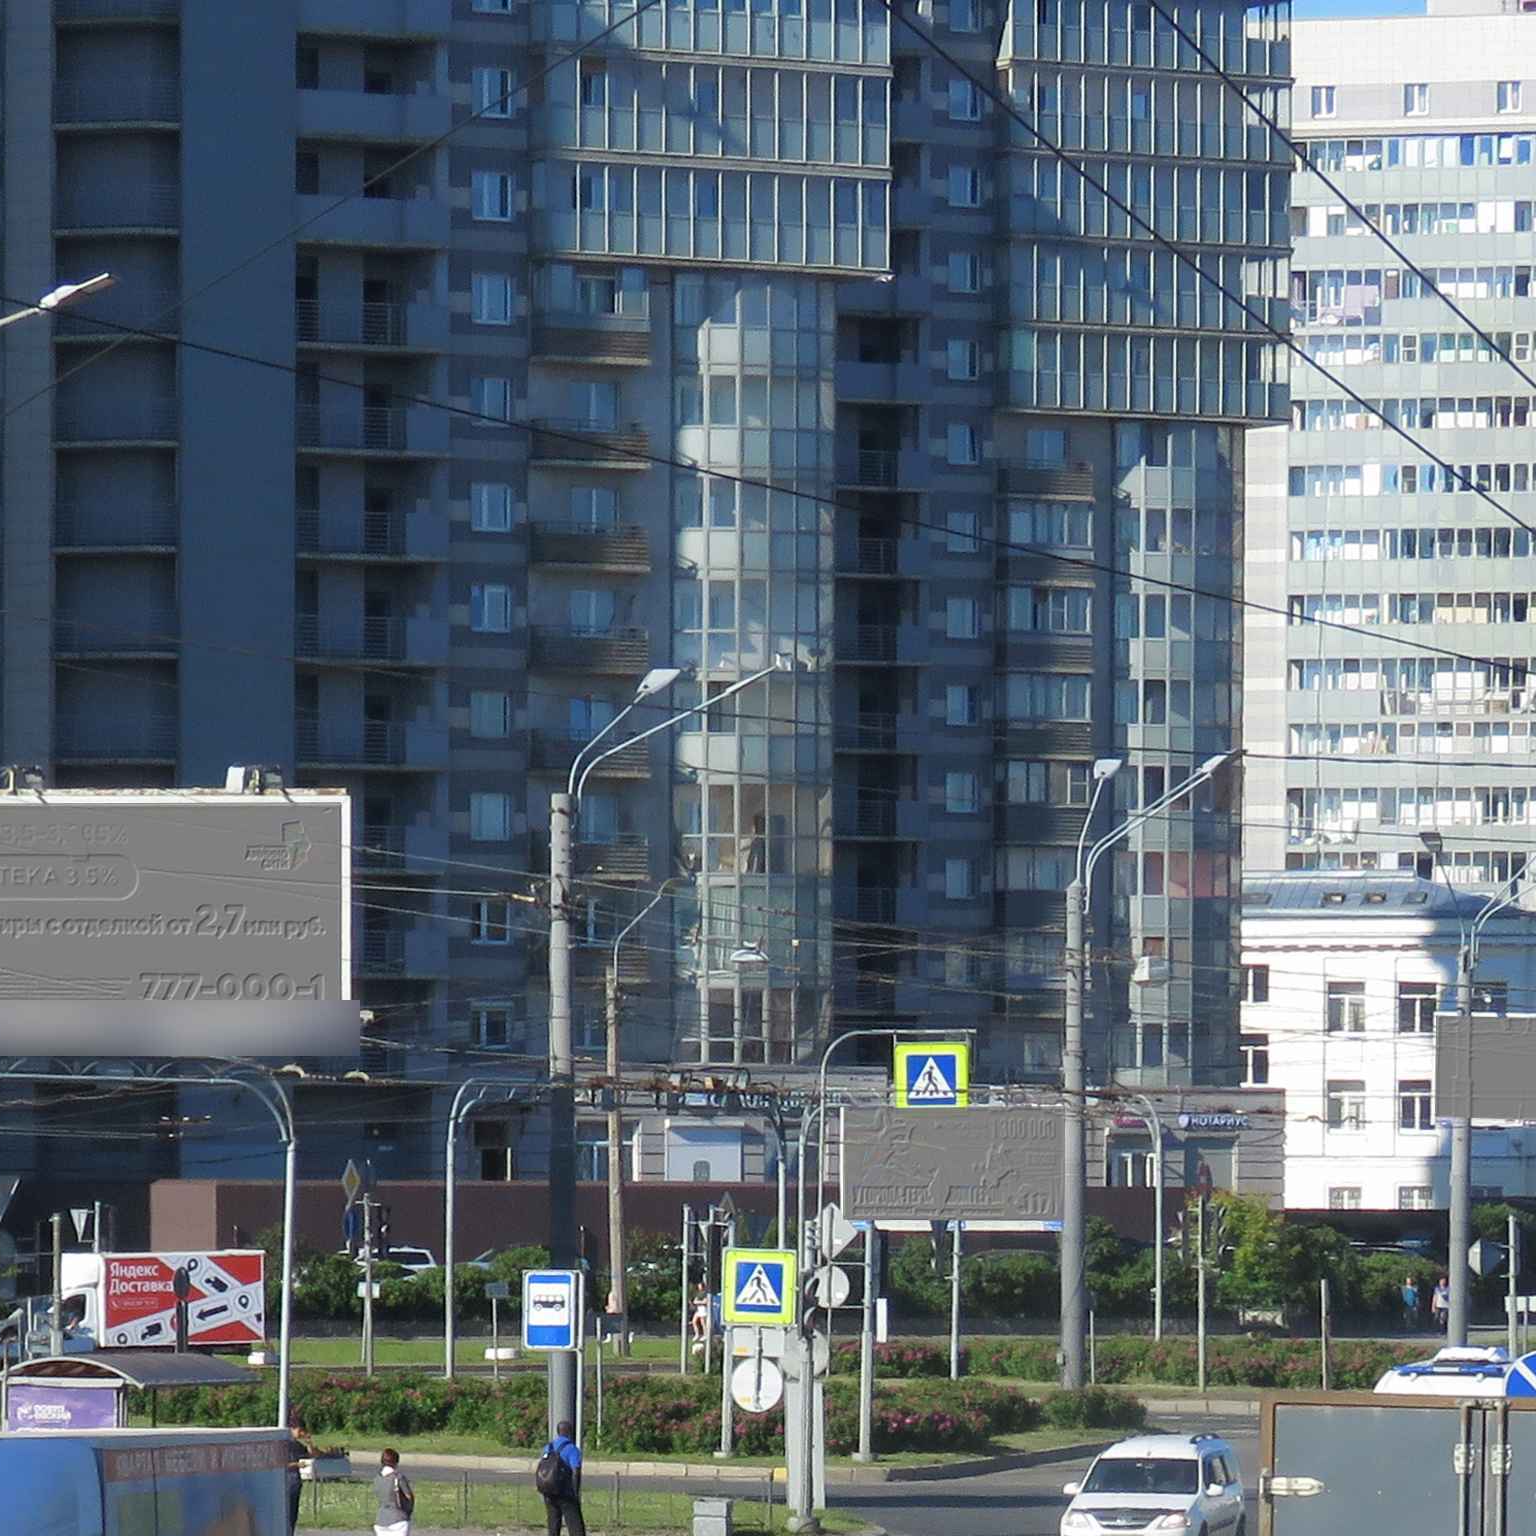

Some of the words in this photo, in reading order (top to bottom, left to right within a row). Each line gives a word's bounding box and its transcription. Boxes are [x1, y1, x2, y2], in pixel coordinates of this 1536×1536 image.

[47, 918, 62, 935] с
[63, 912, 164, 938] отделкой
[166, 918, 193, 936] от
[195, 904, 247, 940] 2,7
[284, 915, 328, 940] руб.
[1191, 1113, 1249, 1126] НОТАРИУС
[109, 1263, 159, 1278] Яндекс
[109, 1279, 174, 1295] Доставка
